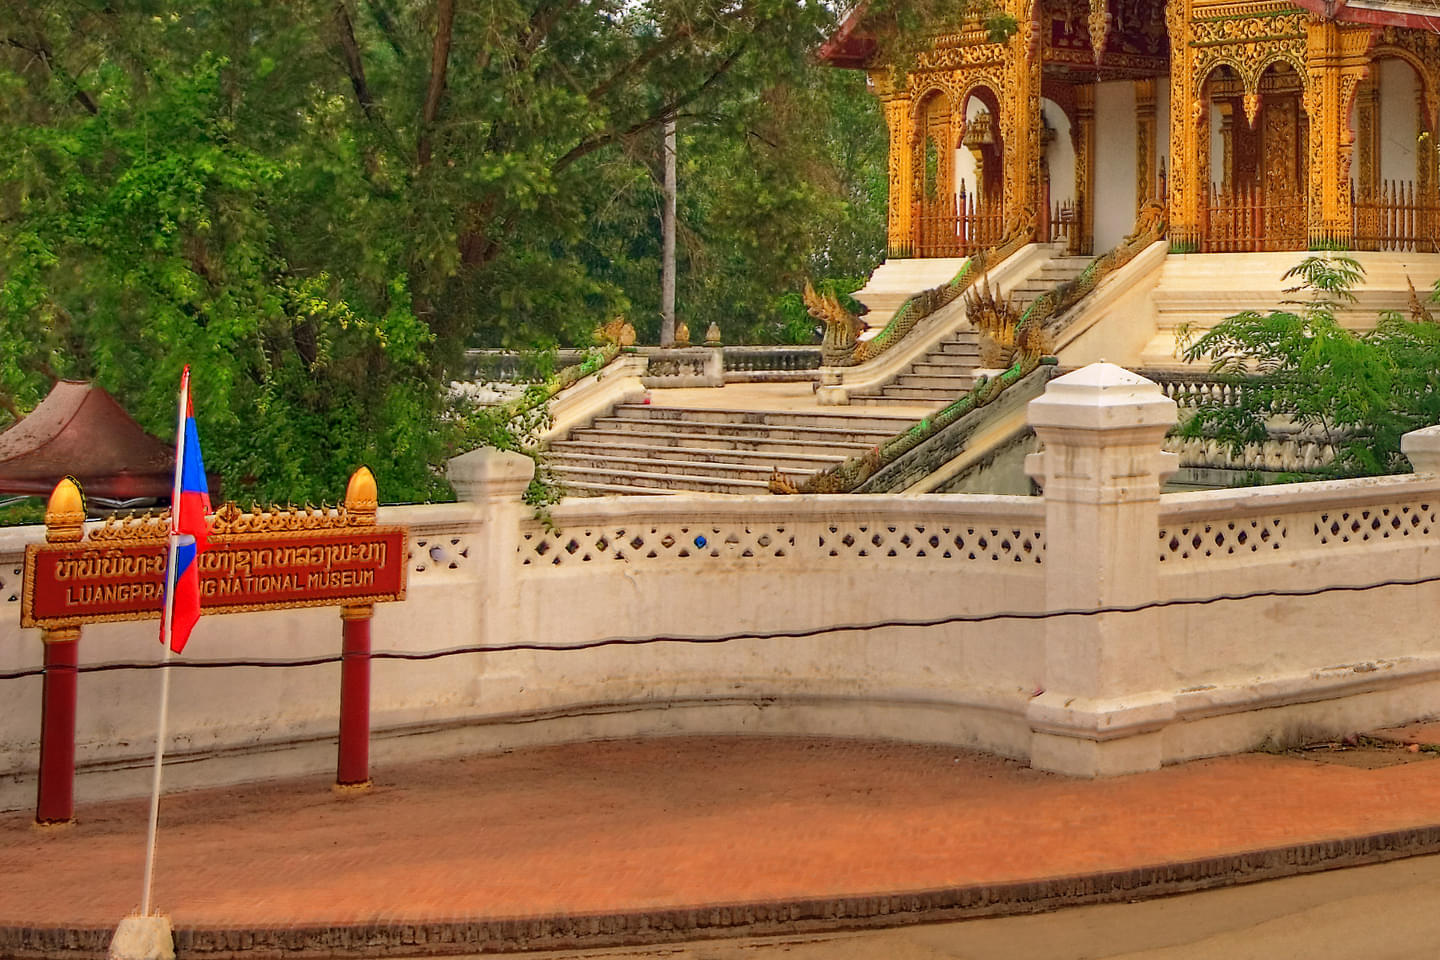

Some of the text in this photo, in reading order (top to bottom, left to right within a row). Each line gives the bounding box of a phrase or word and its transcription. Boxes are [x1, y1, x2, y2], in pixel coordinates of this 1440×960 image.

[66, 568, 375, 606] LUANGPRAG NATIONAL MUSEUM
